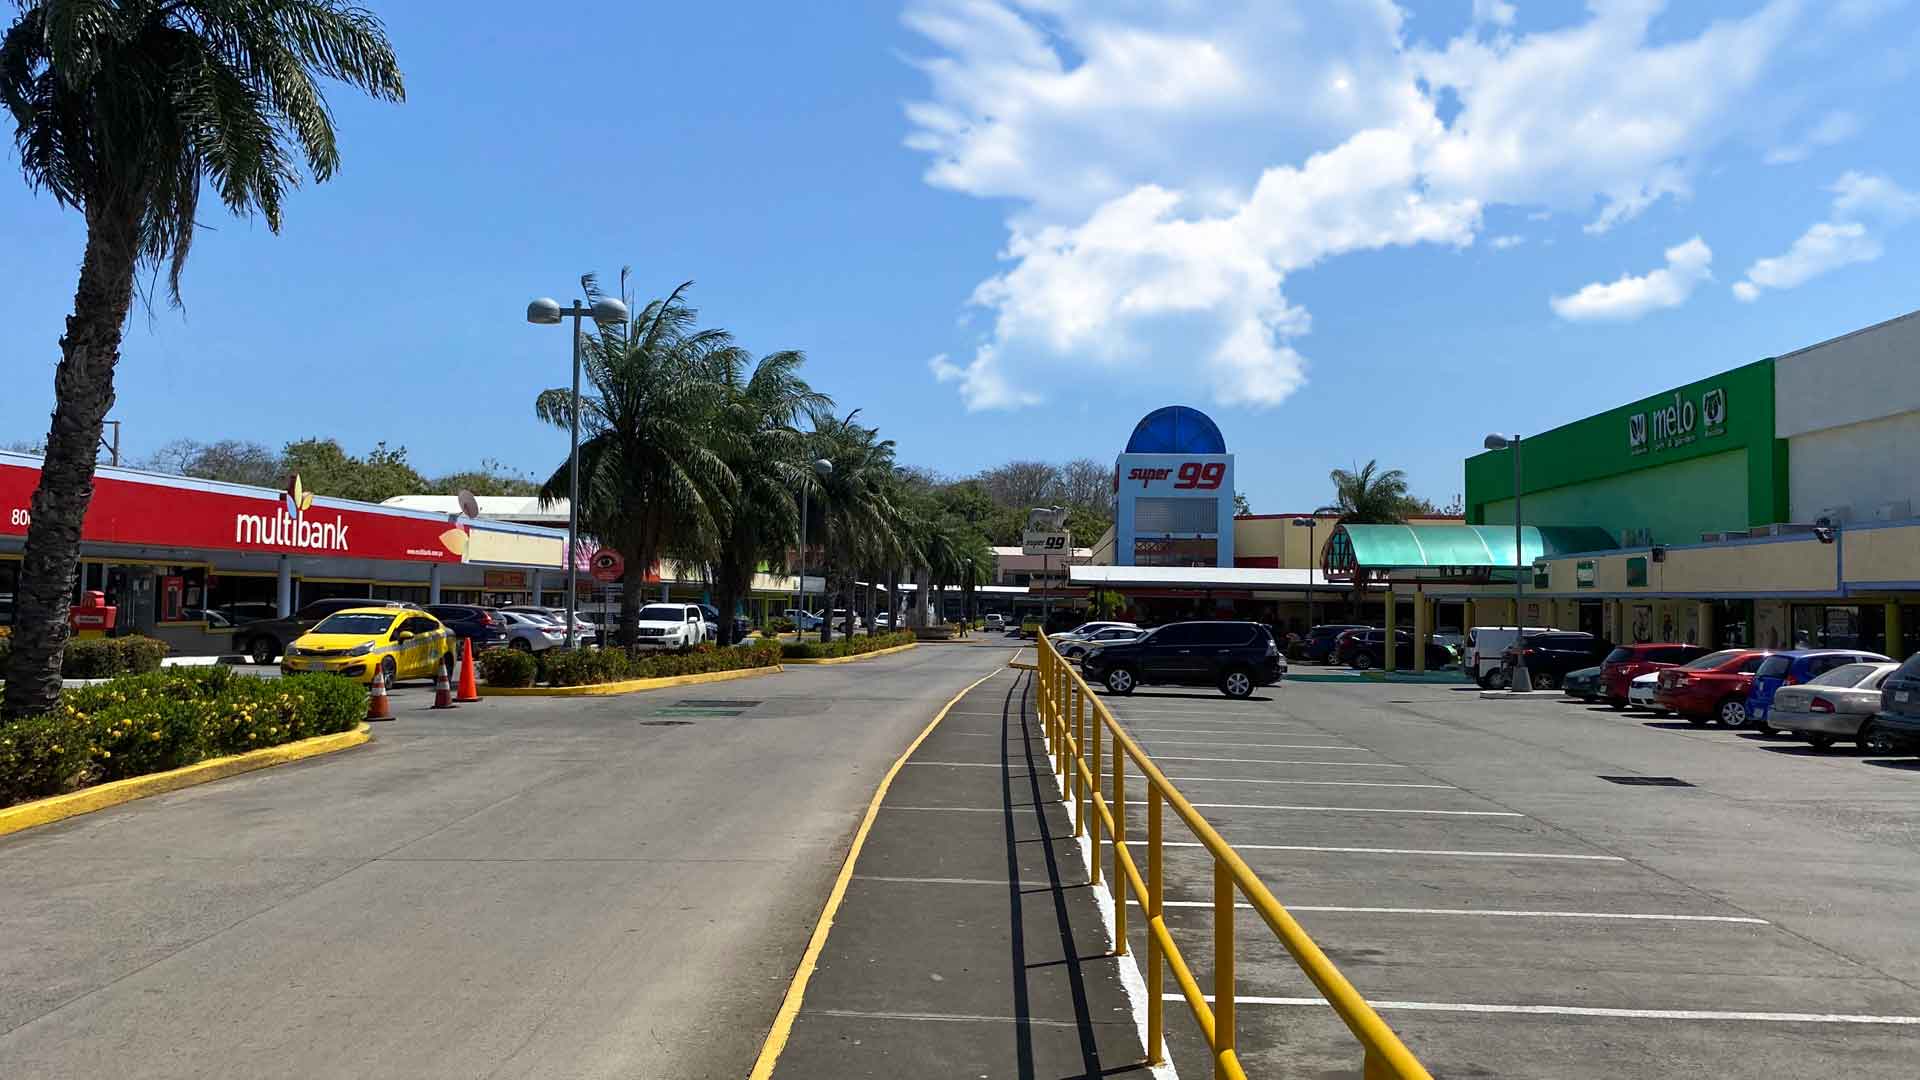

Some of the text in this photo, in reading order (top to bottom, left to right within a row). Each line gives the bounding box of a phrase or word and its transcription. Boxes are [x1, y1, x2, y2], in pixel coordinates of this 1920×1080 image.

[1653, 392, 1694, 441] melo
[1128, 468, 1173, 488] super
[1174, 462, 1226, 490] 99
[236, 507, 348, 551] multibank
[1045, 537, 1065, 549] 99
